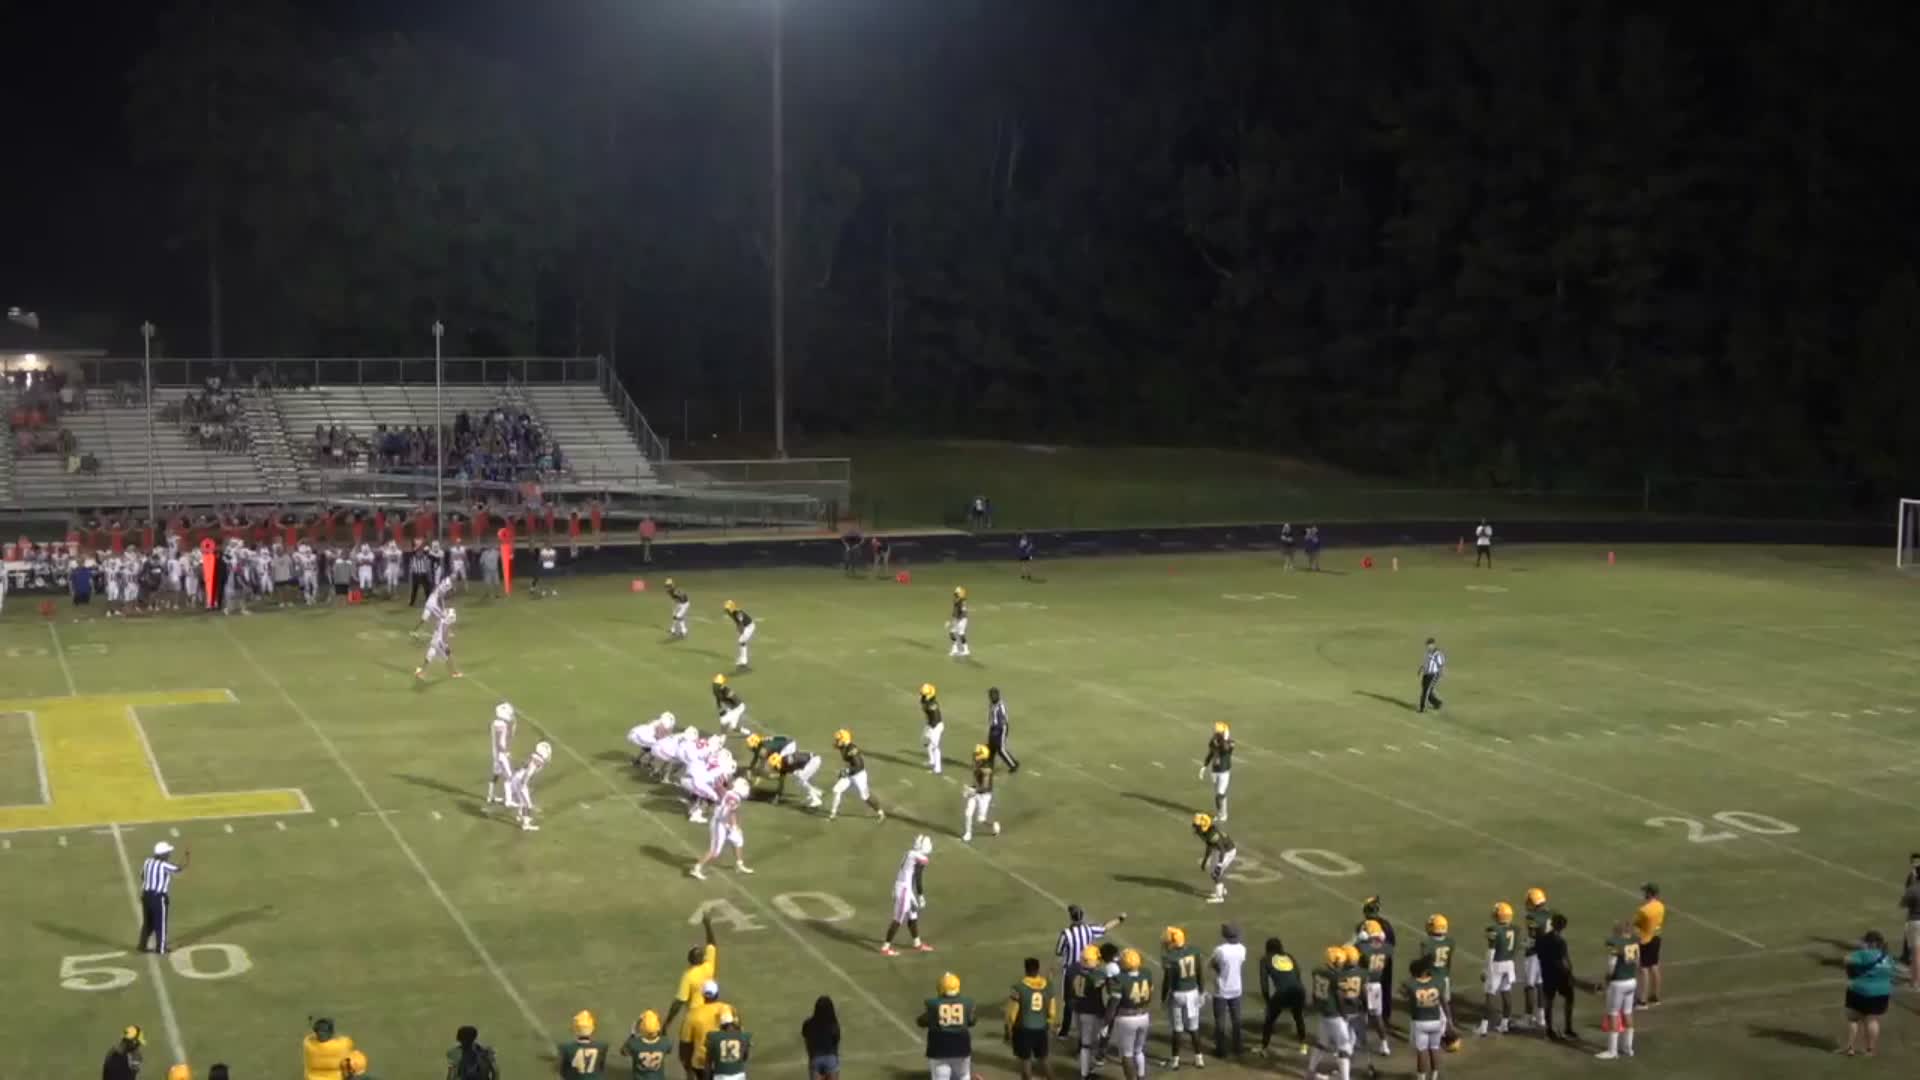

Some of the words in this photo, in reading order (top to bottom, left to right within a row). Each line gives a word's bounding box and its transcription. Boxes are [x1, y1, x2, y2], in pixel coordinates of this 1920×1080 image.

[1645, 810, 1800, 843] 20
[687, 890, 857, 932] 40
[59, 943, 253, 991] 50
[1178, 956, 1196, 979] 17
[571, 1048, 599, 1074] 47
[719, 1039, 741, 1063] 13
